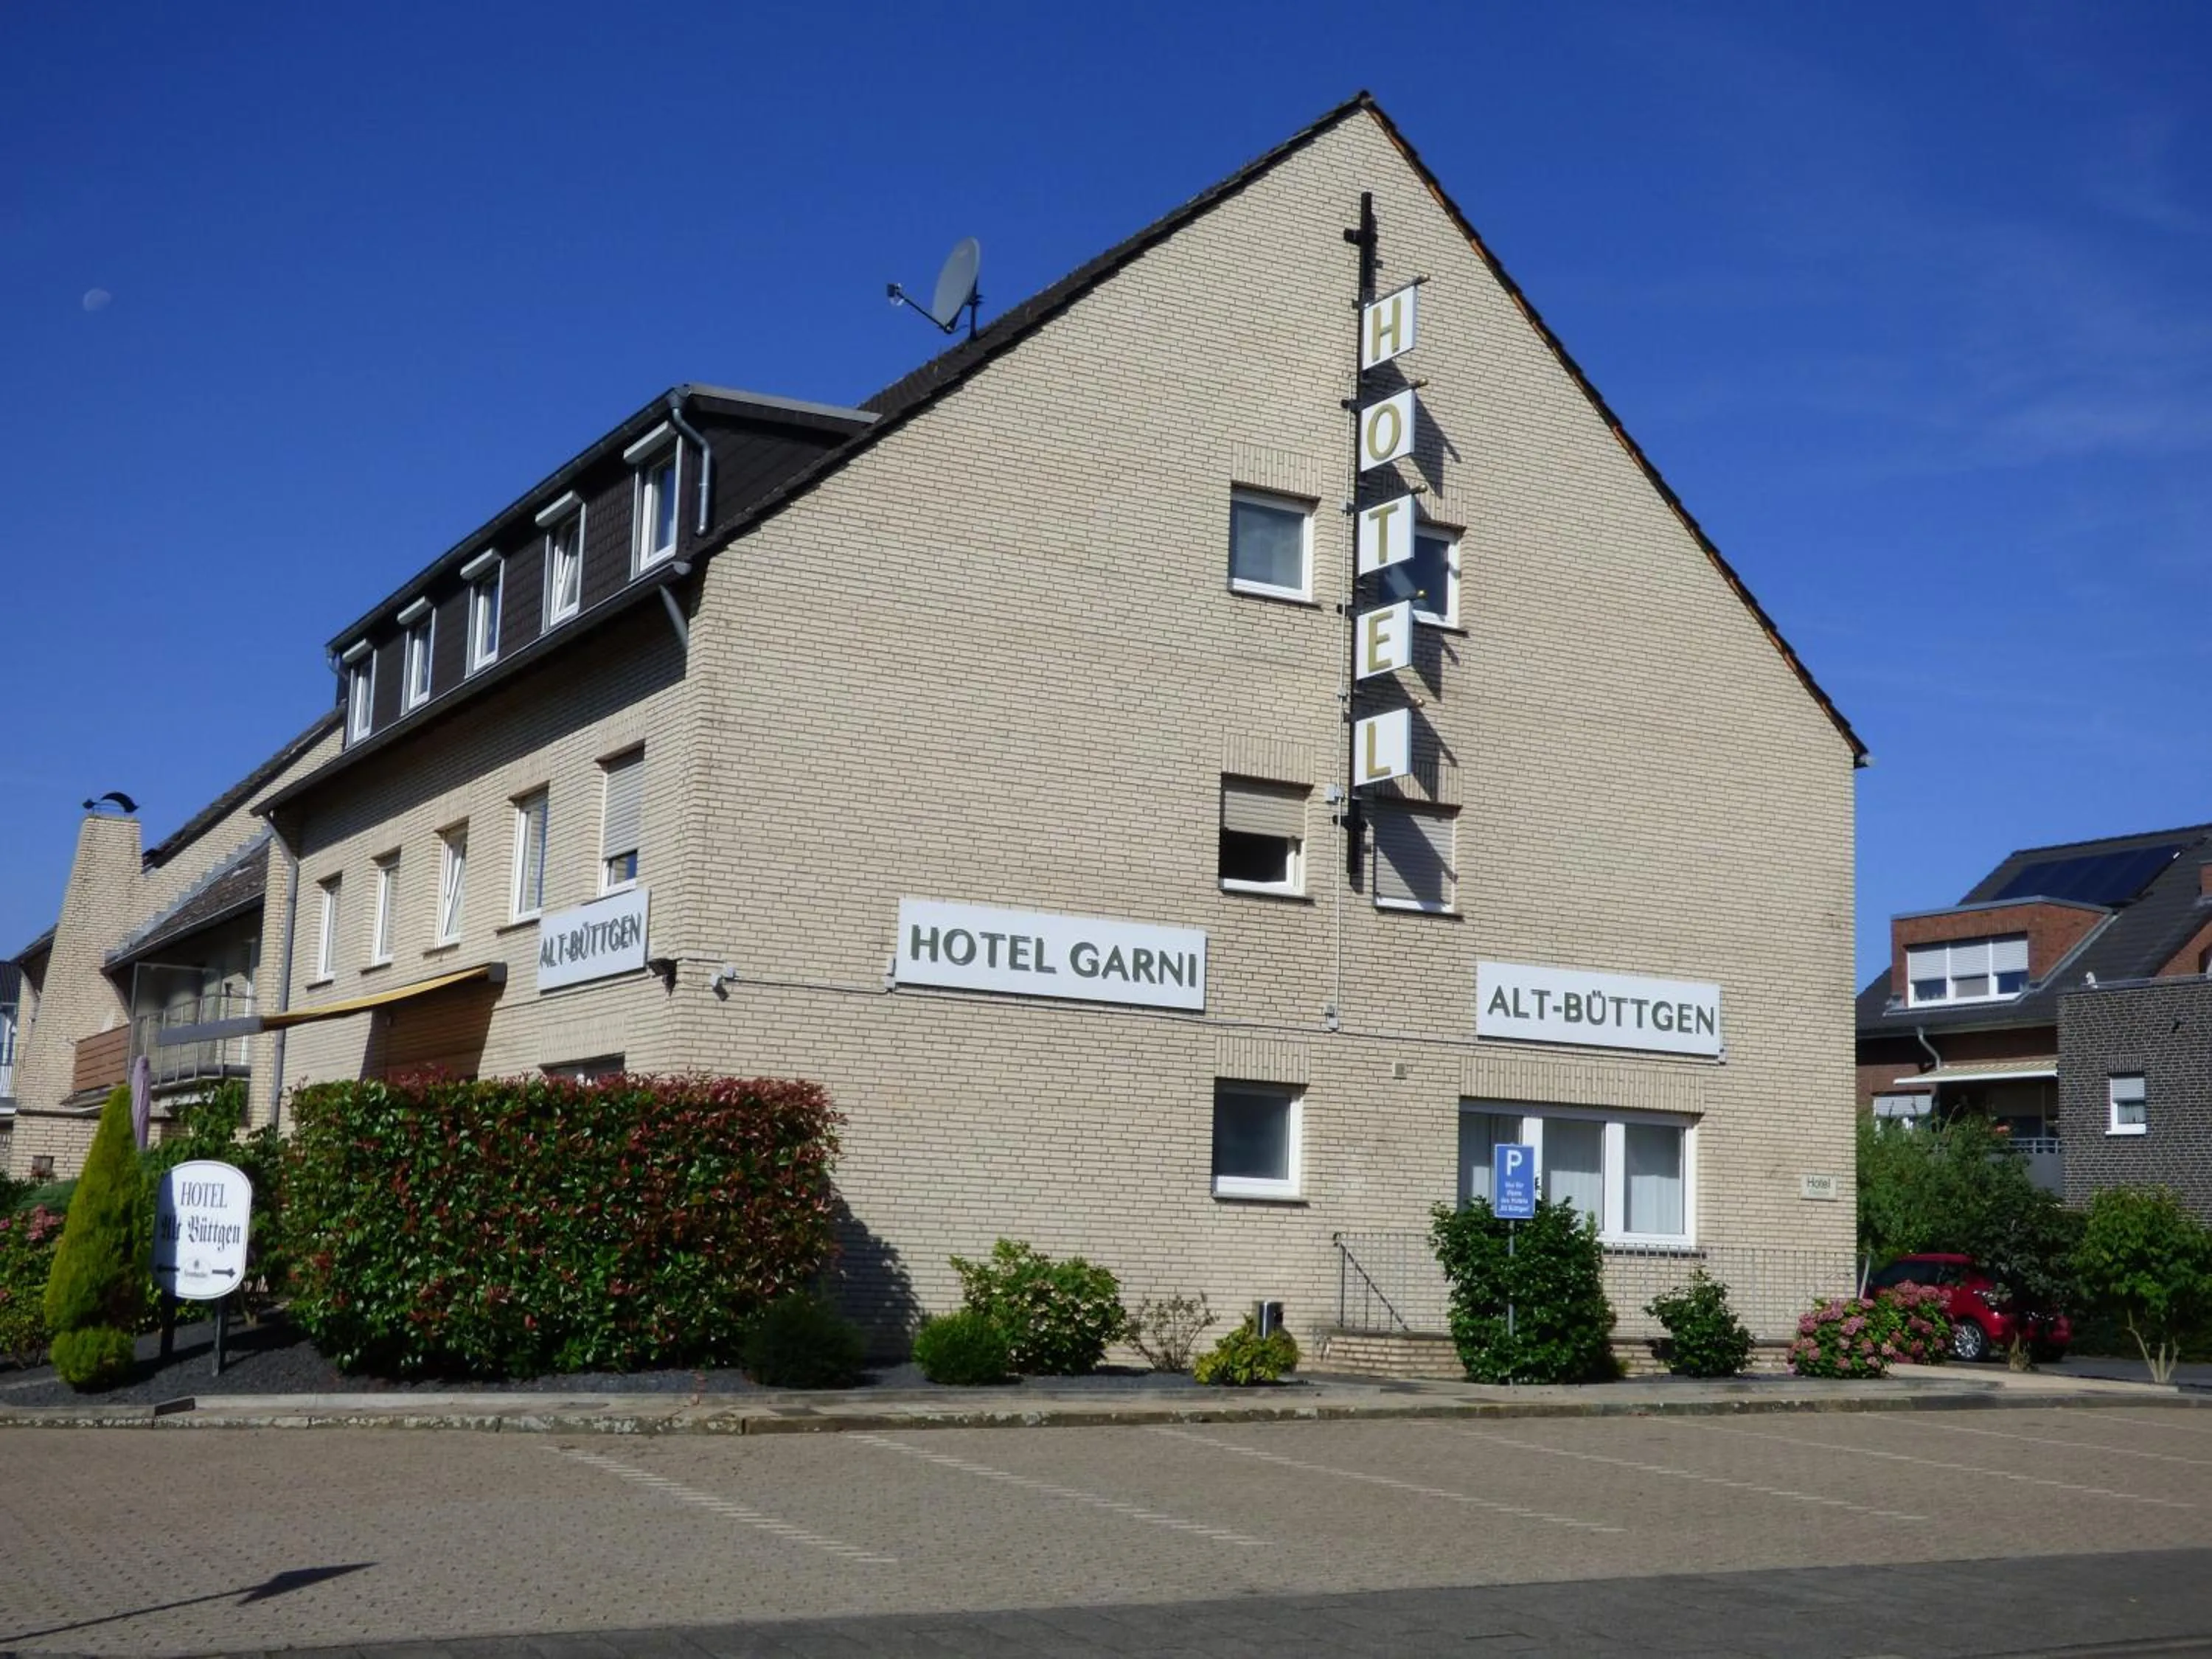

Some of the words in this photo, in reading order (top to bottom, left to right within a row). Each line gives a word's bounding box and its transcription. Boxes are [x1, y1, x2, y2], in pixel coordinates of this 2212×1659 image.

[1366, 303, 1402, 780] HOTEL
[539, 911, 641, 969] ALT-BÜTTGEN
[911, 924, 1057, 975] HOTEL
[1069, 942, 1197, 988] GARNI
[1487, 985, 1715, 1036] ALT-BÜTTGEN
[1506, 1150, 1523, 1177] P
[1806, 1176, 1831, 1189] Hotel
[180, 1181, 228, 1208] HOTEL
[187, 1215, 241, 1252] Büttgen
